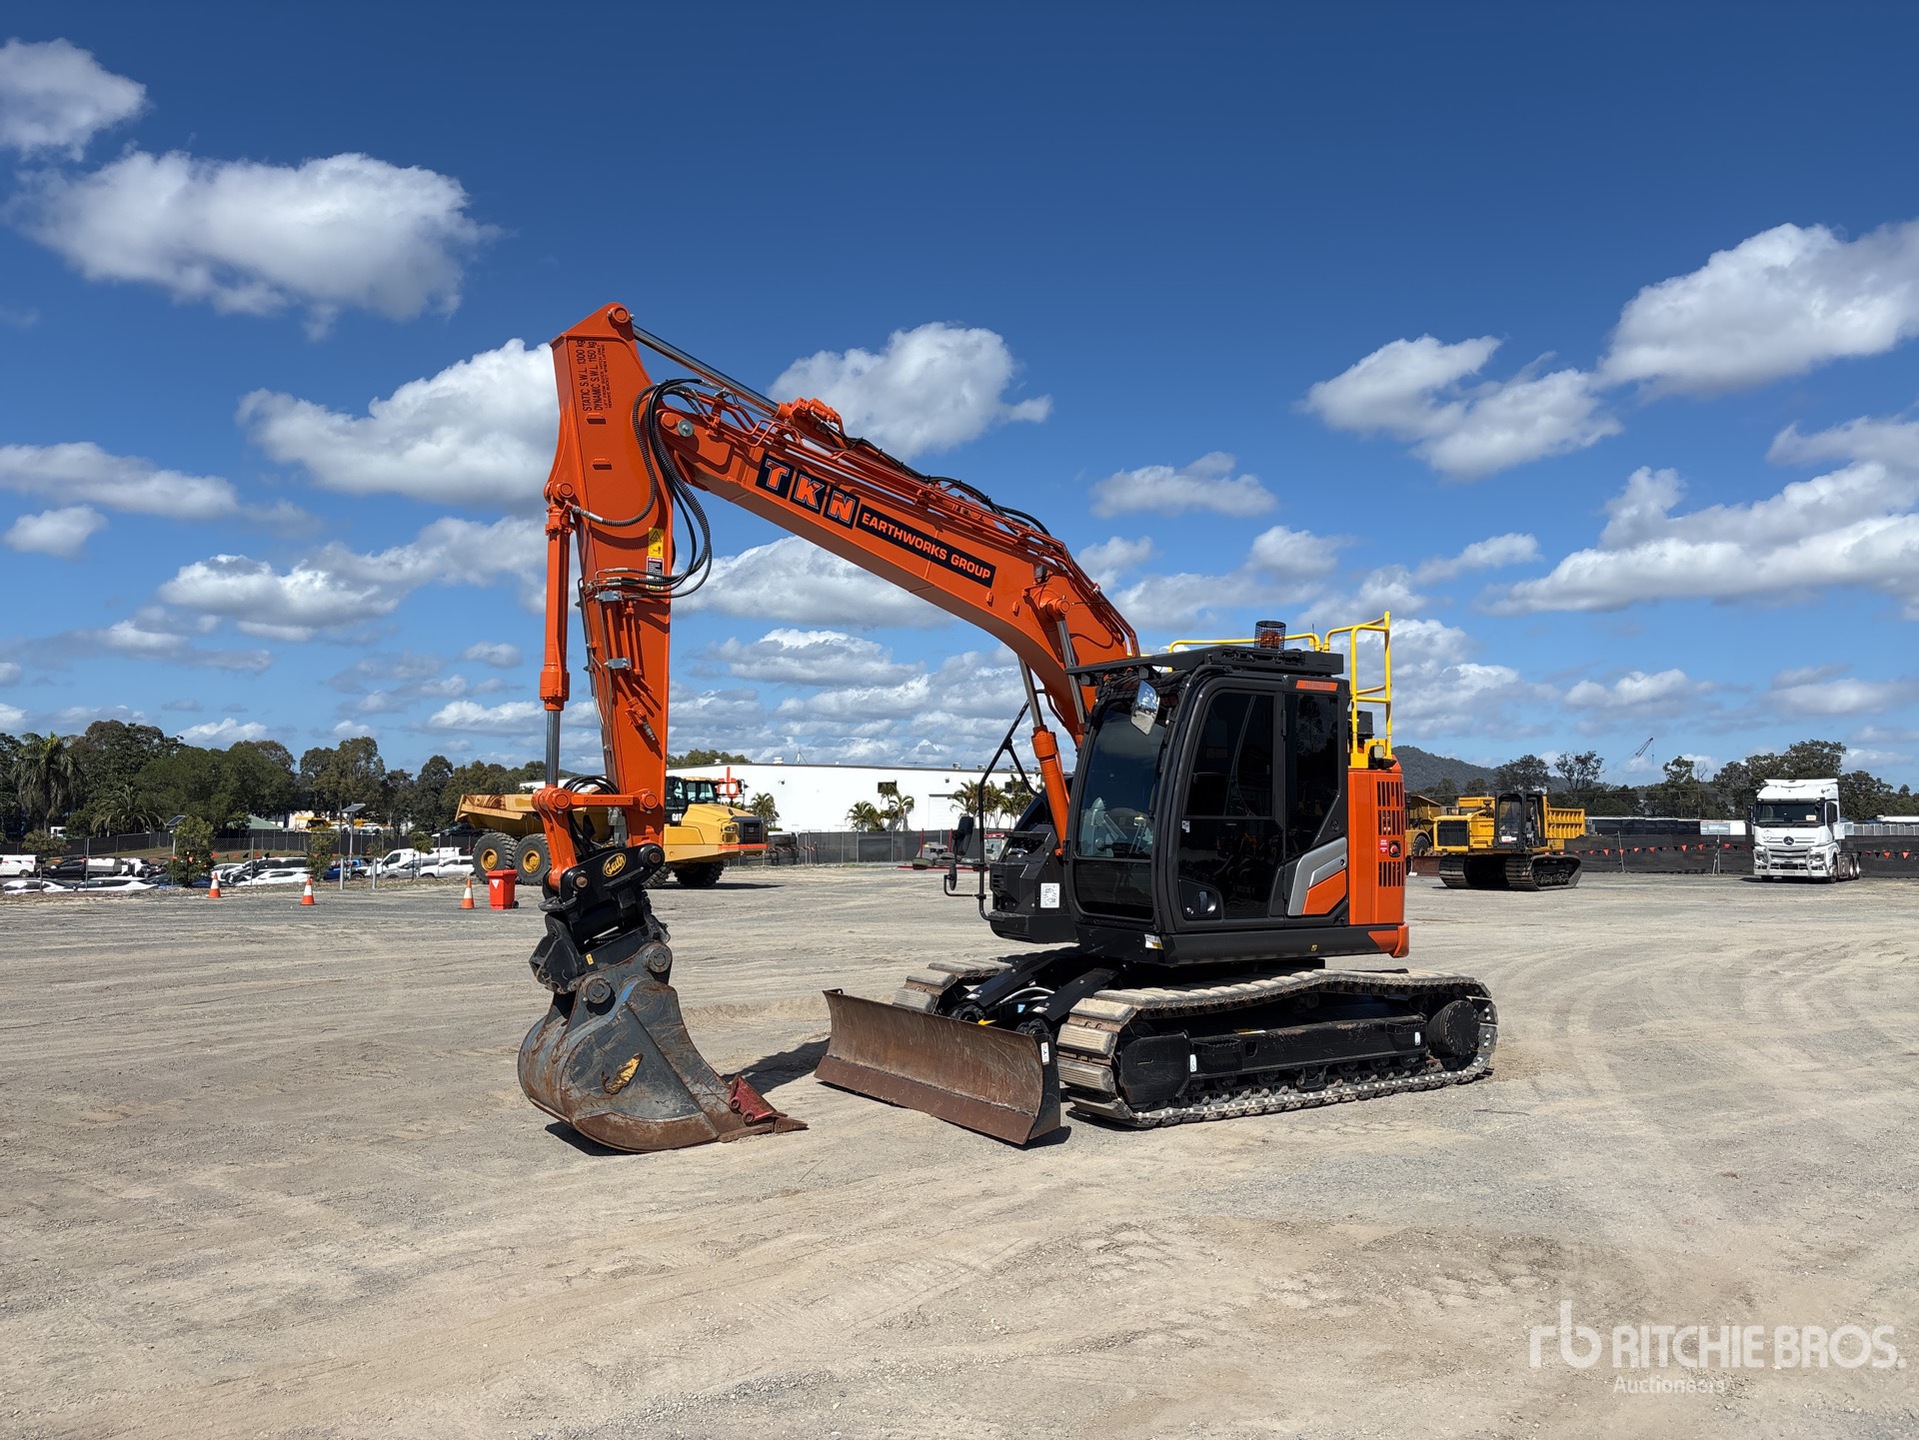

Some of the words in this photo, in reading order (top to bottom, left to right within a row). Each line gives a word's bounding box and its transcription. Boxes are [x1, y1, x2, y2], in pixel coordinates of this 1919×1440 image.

[587, 341, 597, 349] kg
[577, 349, 586, 365] 1300
[587, 349, 597, 363] 1150
[582, 389, 592, 412] STATIC
[592, 384, 603, 411] DYNAMIC
[861, 512, 948, 561] EARTHWORKS
[951, 555, 992, 580] GROUP
